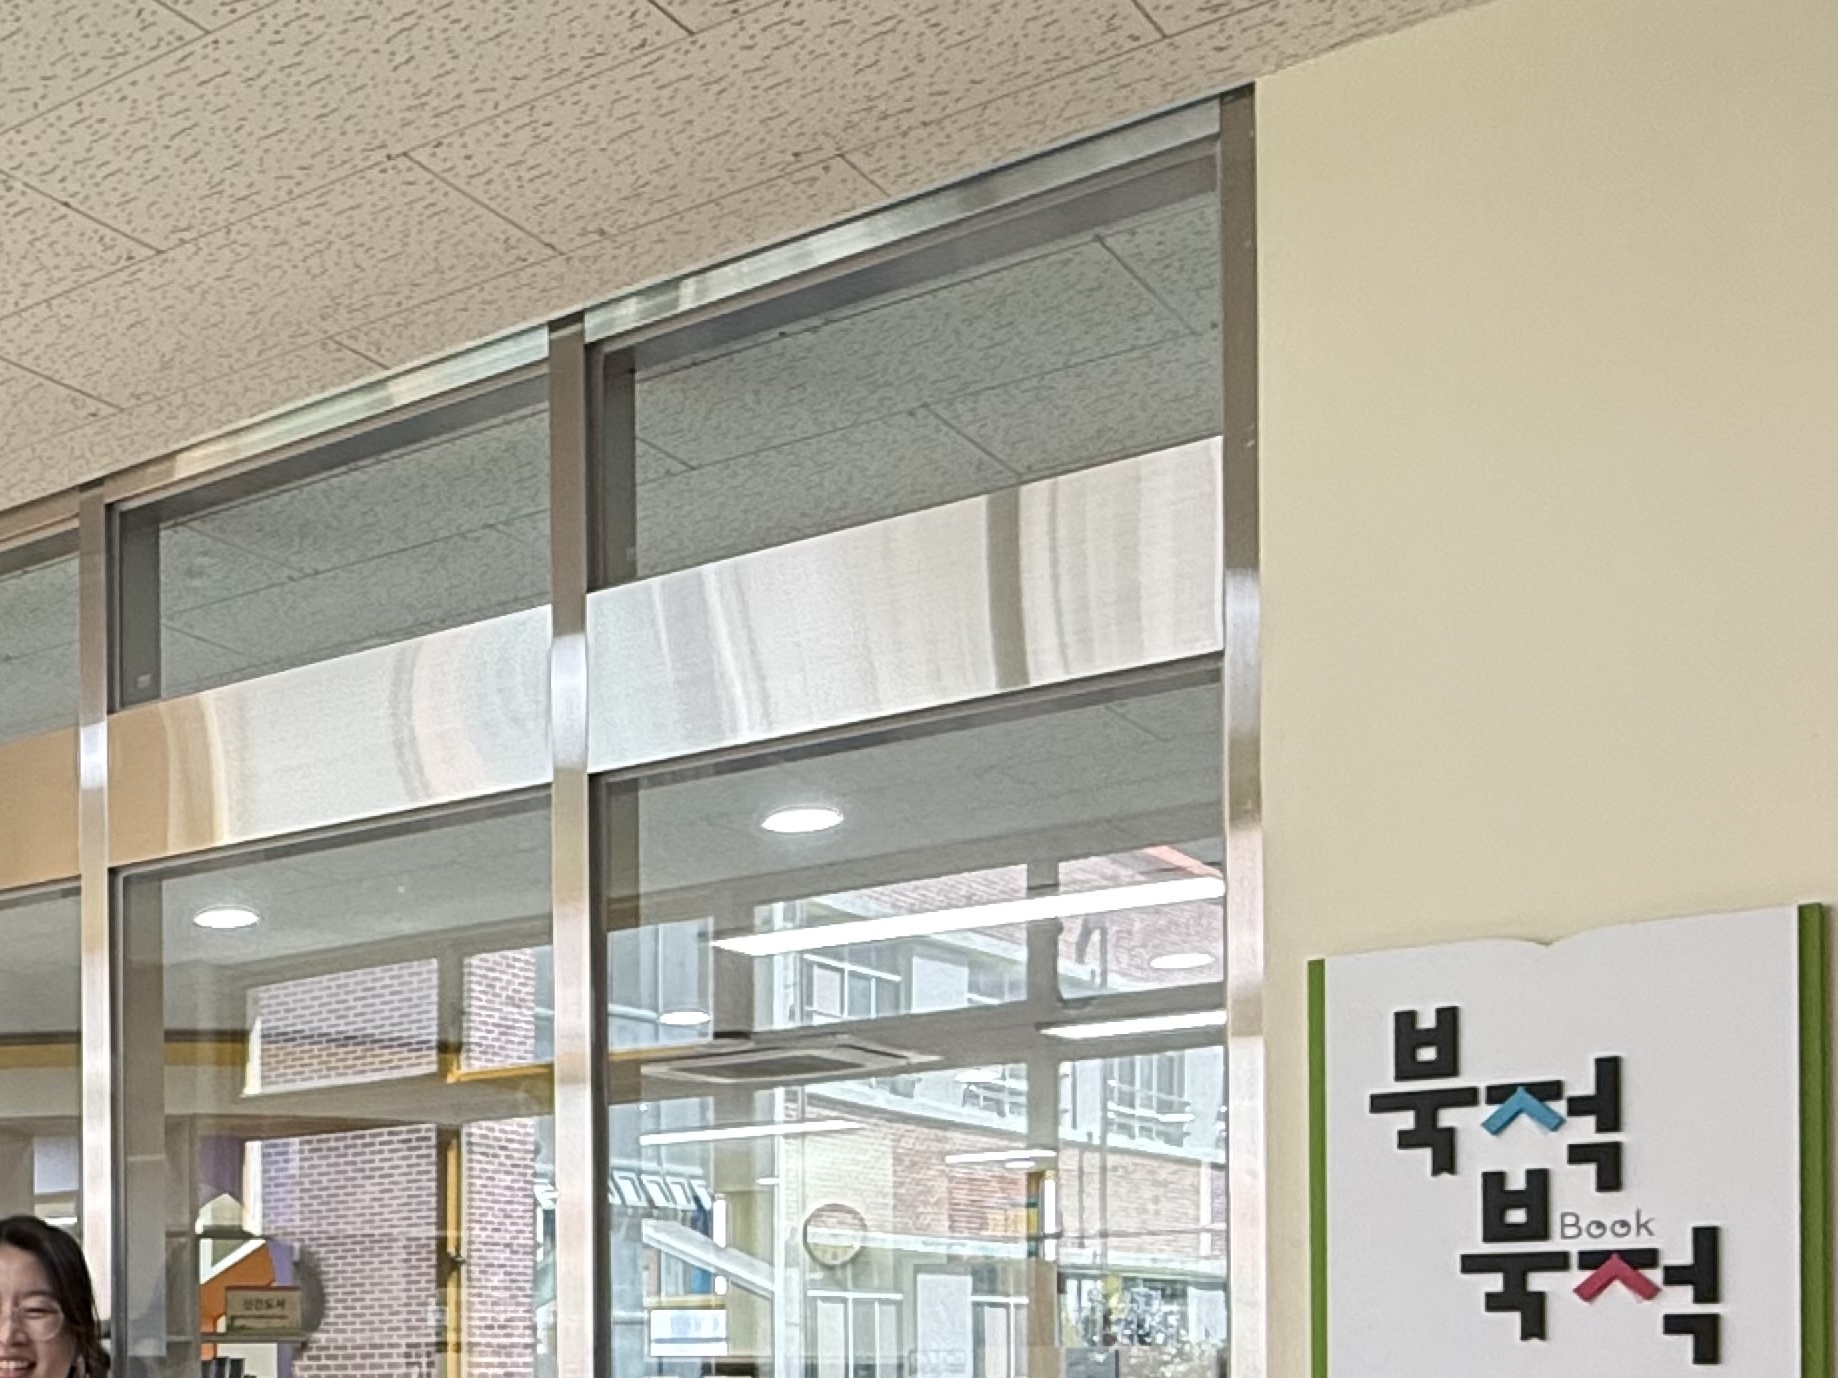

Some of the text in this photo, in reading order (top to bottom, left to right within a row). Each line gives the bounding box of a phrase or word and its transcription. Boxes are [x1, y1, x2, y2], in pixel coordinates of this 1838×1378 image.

[1369, 1004, 1622, 1193] 북적
[1460, 1167, 1721, 1366] 북적
[1559, 1208, 1656, 1240] Book
